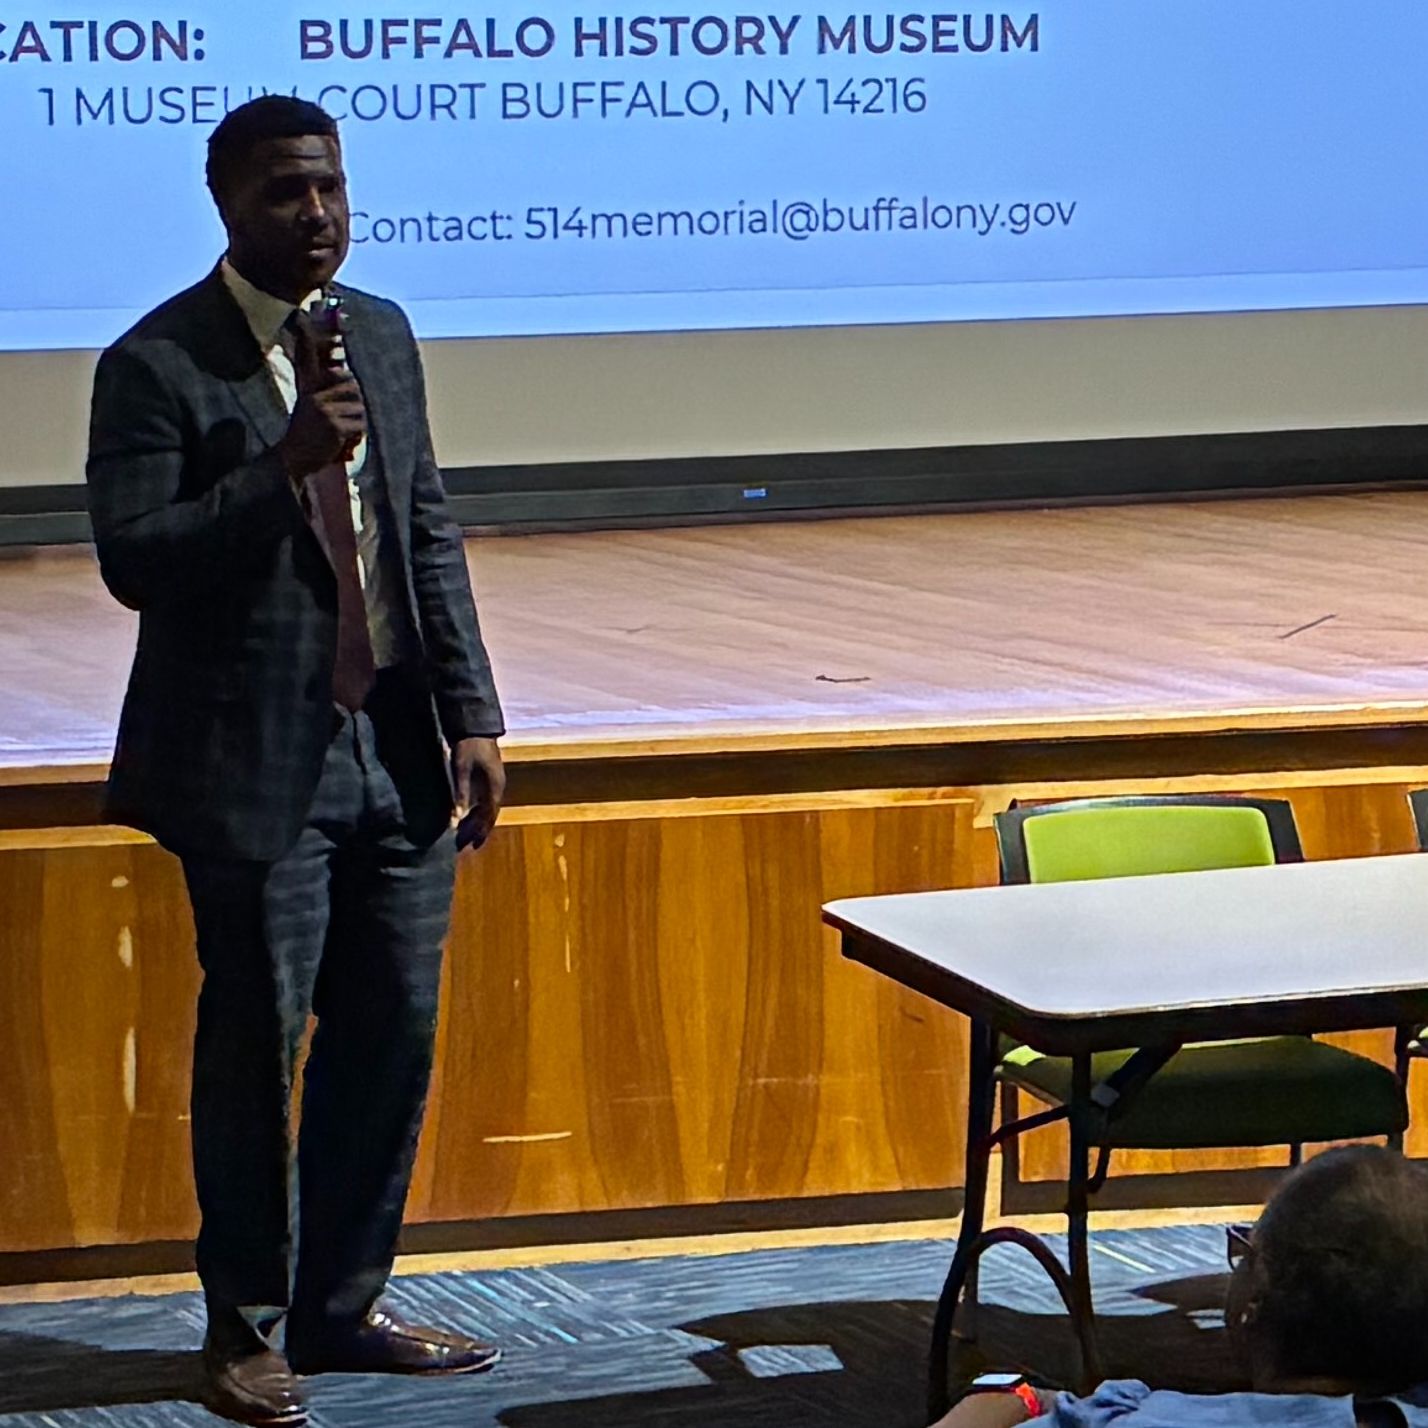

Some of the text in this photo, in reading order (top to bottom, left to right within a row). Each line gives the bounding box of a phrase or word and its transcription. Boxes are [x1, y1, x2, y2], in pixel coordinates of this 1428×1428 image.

[300, 17, 555, 60] BUFFALO
[574, 15, 801, 57] HISTORY
[817, 14, 1038, 54] MUSEUM
[38, 78, 926, 125] 1 MUSEU COURT BUFFALO, NY 14216
[349, 196, 1076, 244] Contact: 514memorial@buffalony.gov
